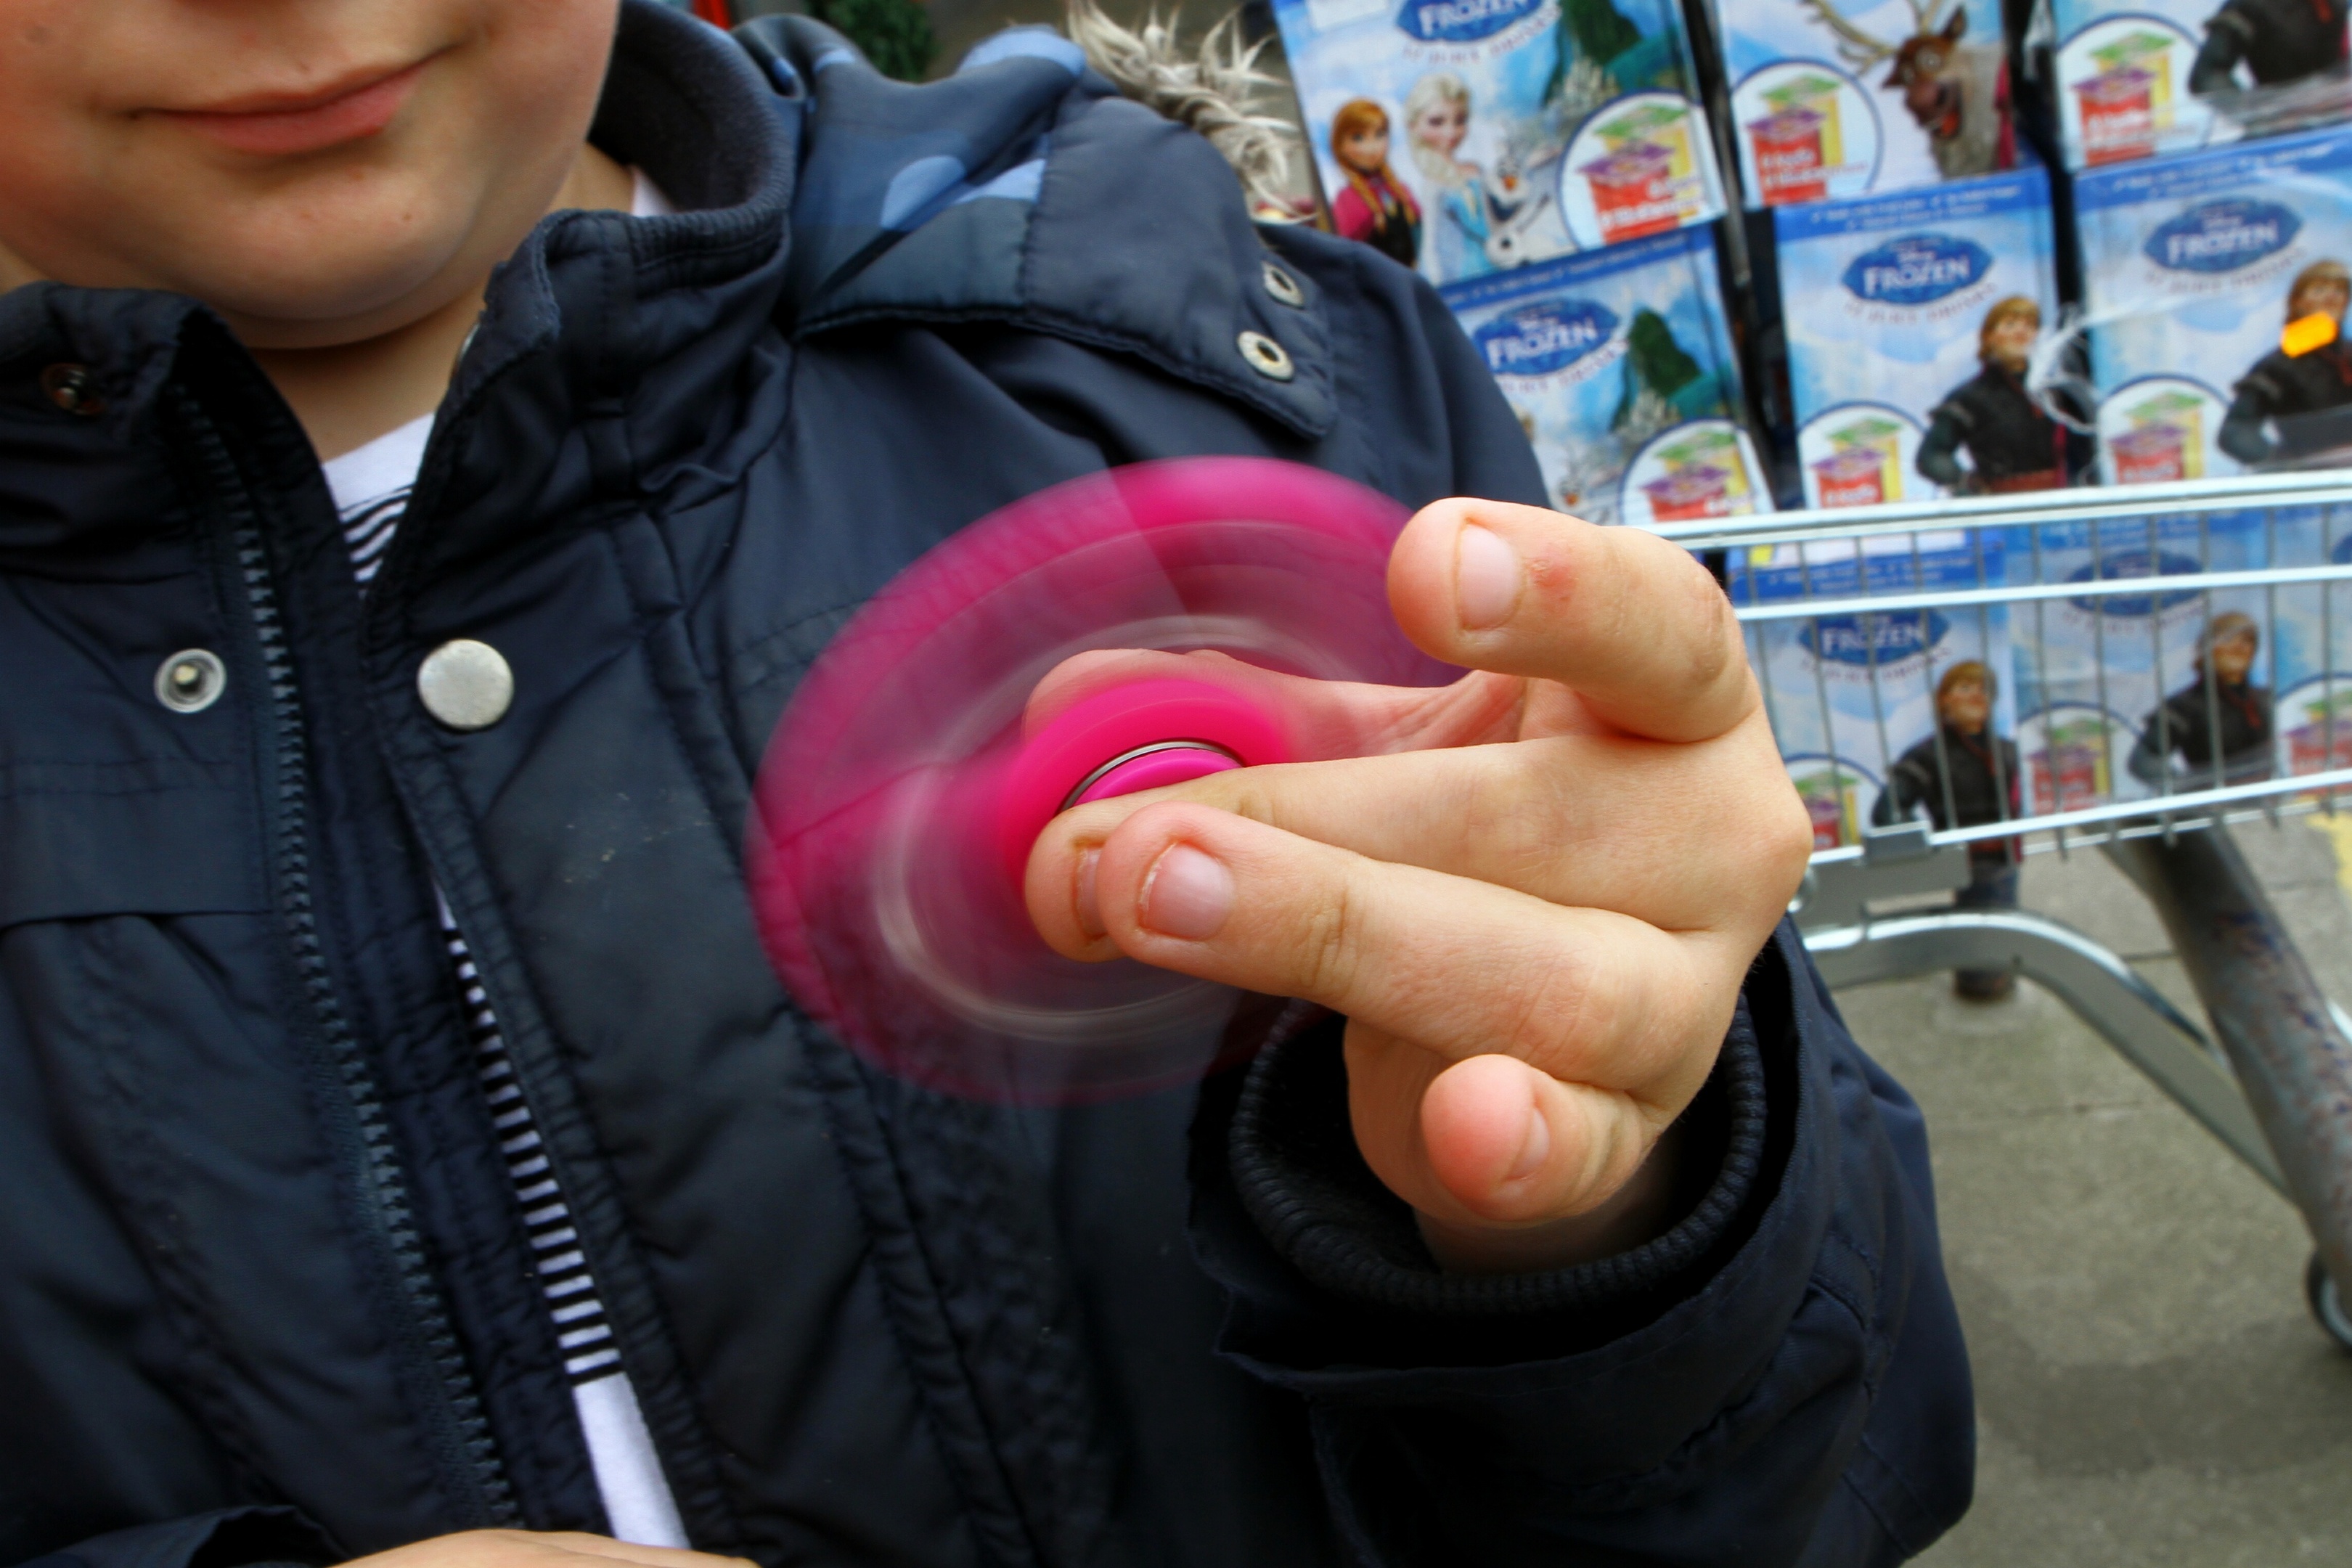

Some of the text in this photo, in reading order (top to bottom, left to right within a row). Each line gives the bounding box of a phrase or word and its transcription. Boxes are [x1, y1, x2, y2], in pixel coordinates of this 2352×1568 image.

[2165, 219, 2279, 265] FROZEN
[1863, 256, 1970, 296] FROZEN
[1487, 317, 1598, 369] FROZEN
